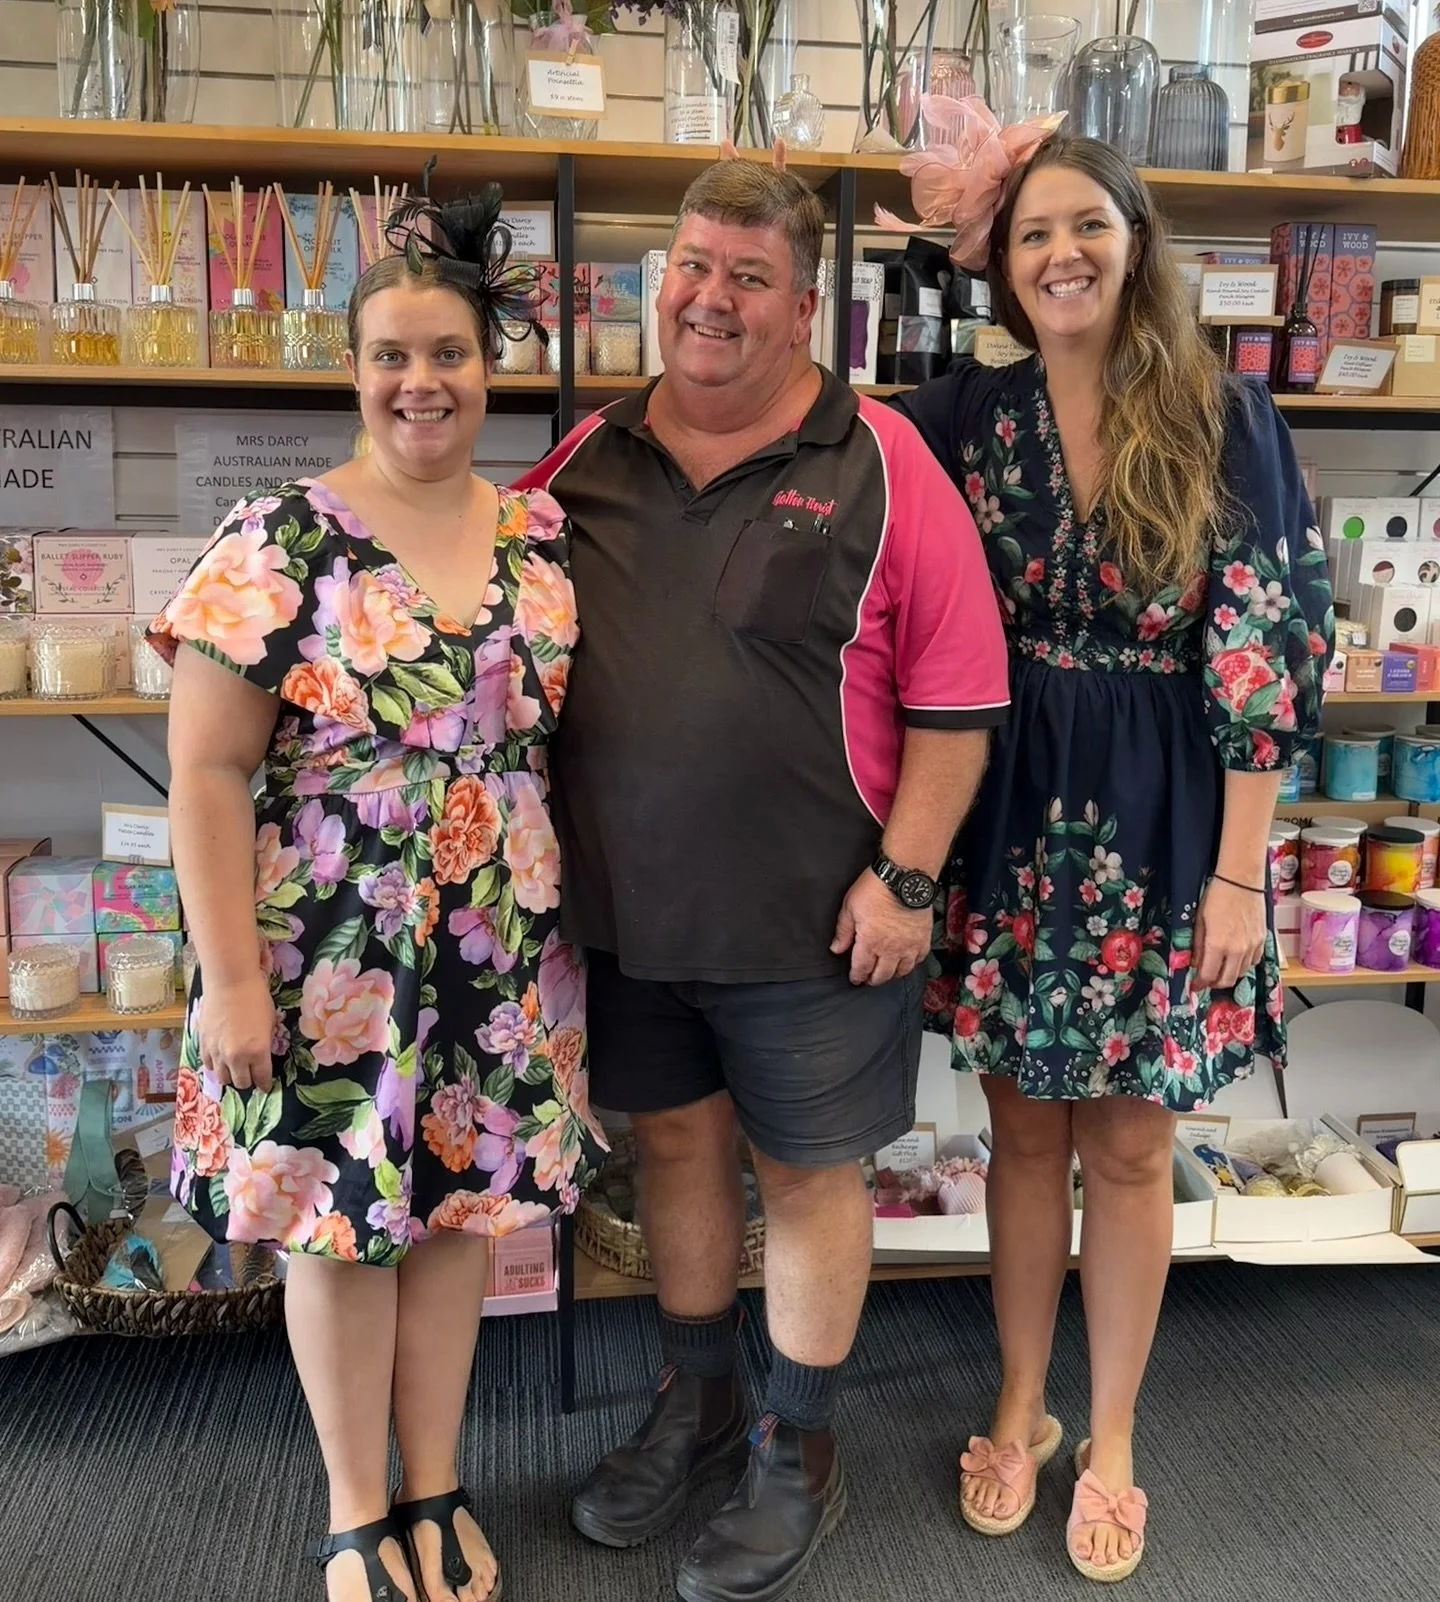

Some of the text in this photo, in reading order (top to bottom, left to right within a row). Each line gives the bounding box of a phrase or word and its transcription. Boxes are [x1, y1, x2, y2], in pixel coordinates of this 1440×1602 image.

[547, 69, 580, 77] Artificial
[547, 77, 584, 86] Poinsettia
[1343, 232, 1370, 241] IVY &
[1342, 240, 1369, 249] WOOD
[574, 285, 589, 294] LUB
[1219, 281, 1229, 289] Ivy
[0, 428, 92, 449] RALIAN
[236, 435, 309, 447] MRS DARCY
[213, 456, 332, 468] AUSTRALIAN MADE
[0, 468, 54, 489] ADE
[195, 476, 252, 488] CANDLES
[255, 477, 283, 488] AND
[215, 496, 237, 507] Can
[504, 1262, 545, 1276] ADULTING
[518, 1275, 546, 1289] SUCKS
